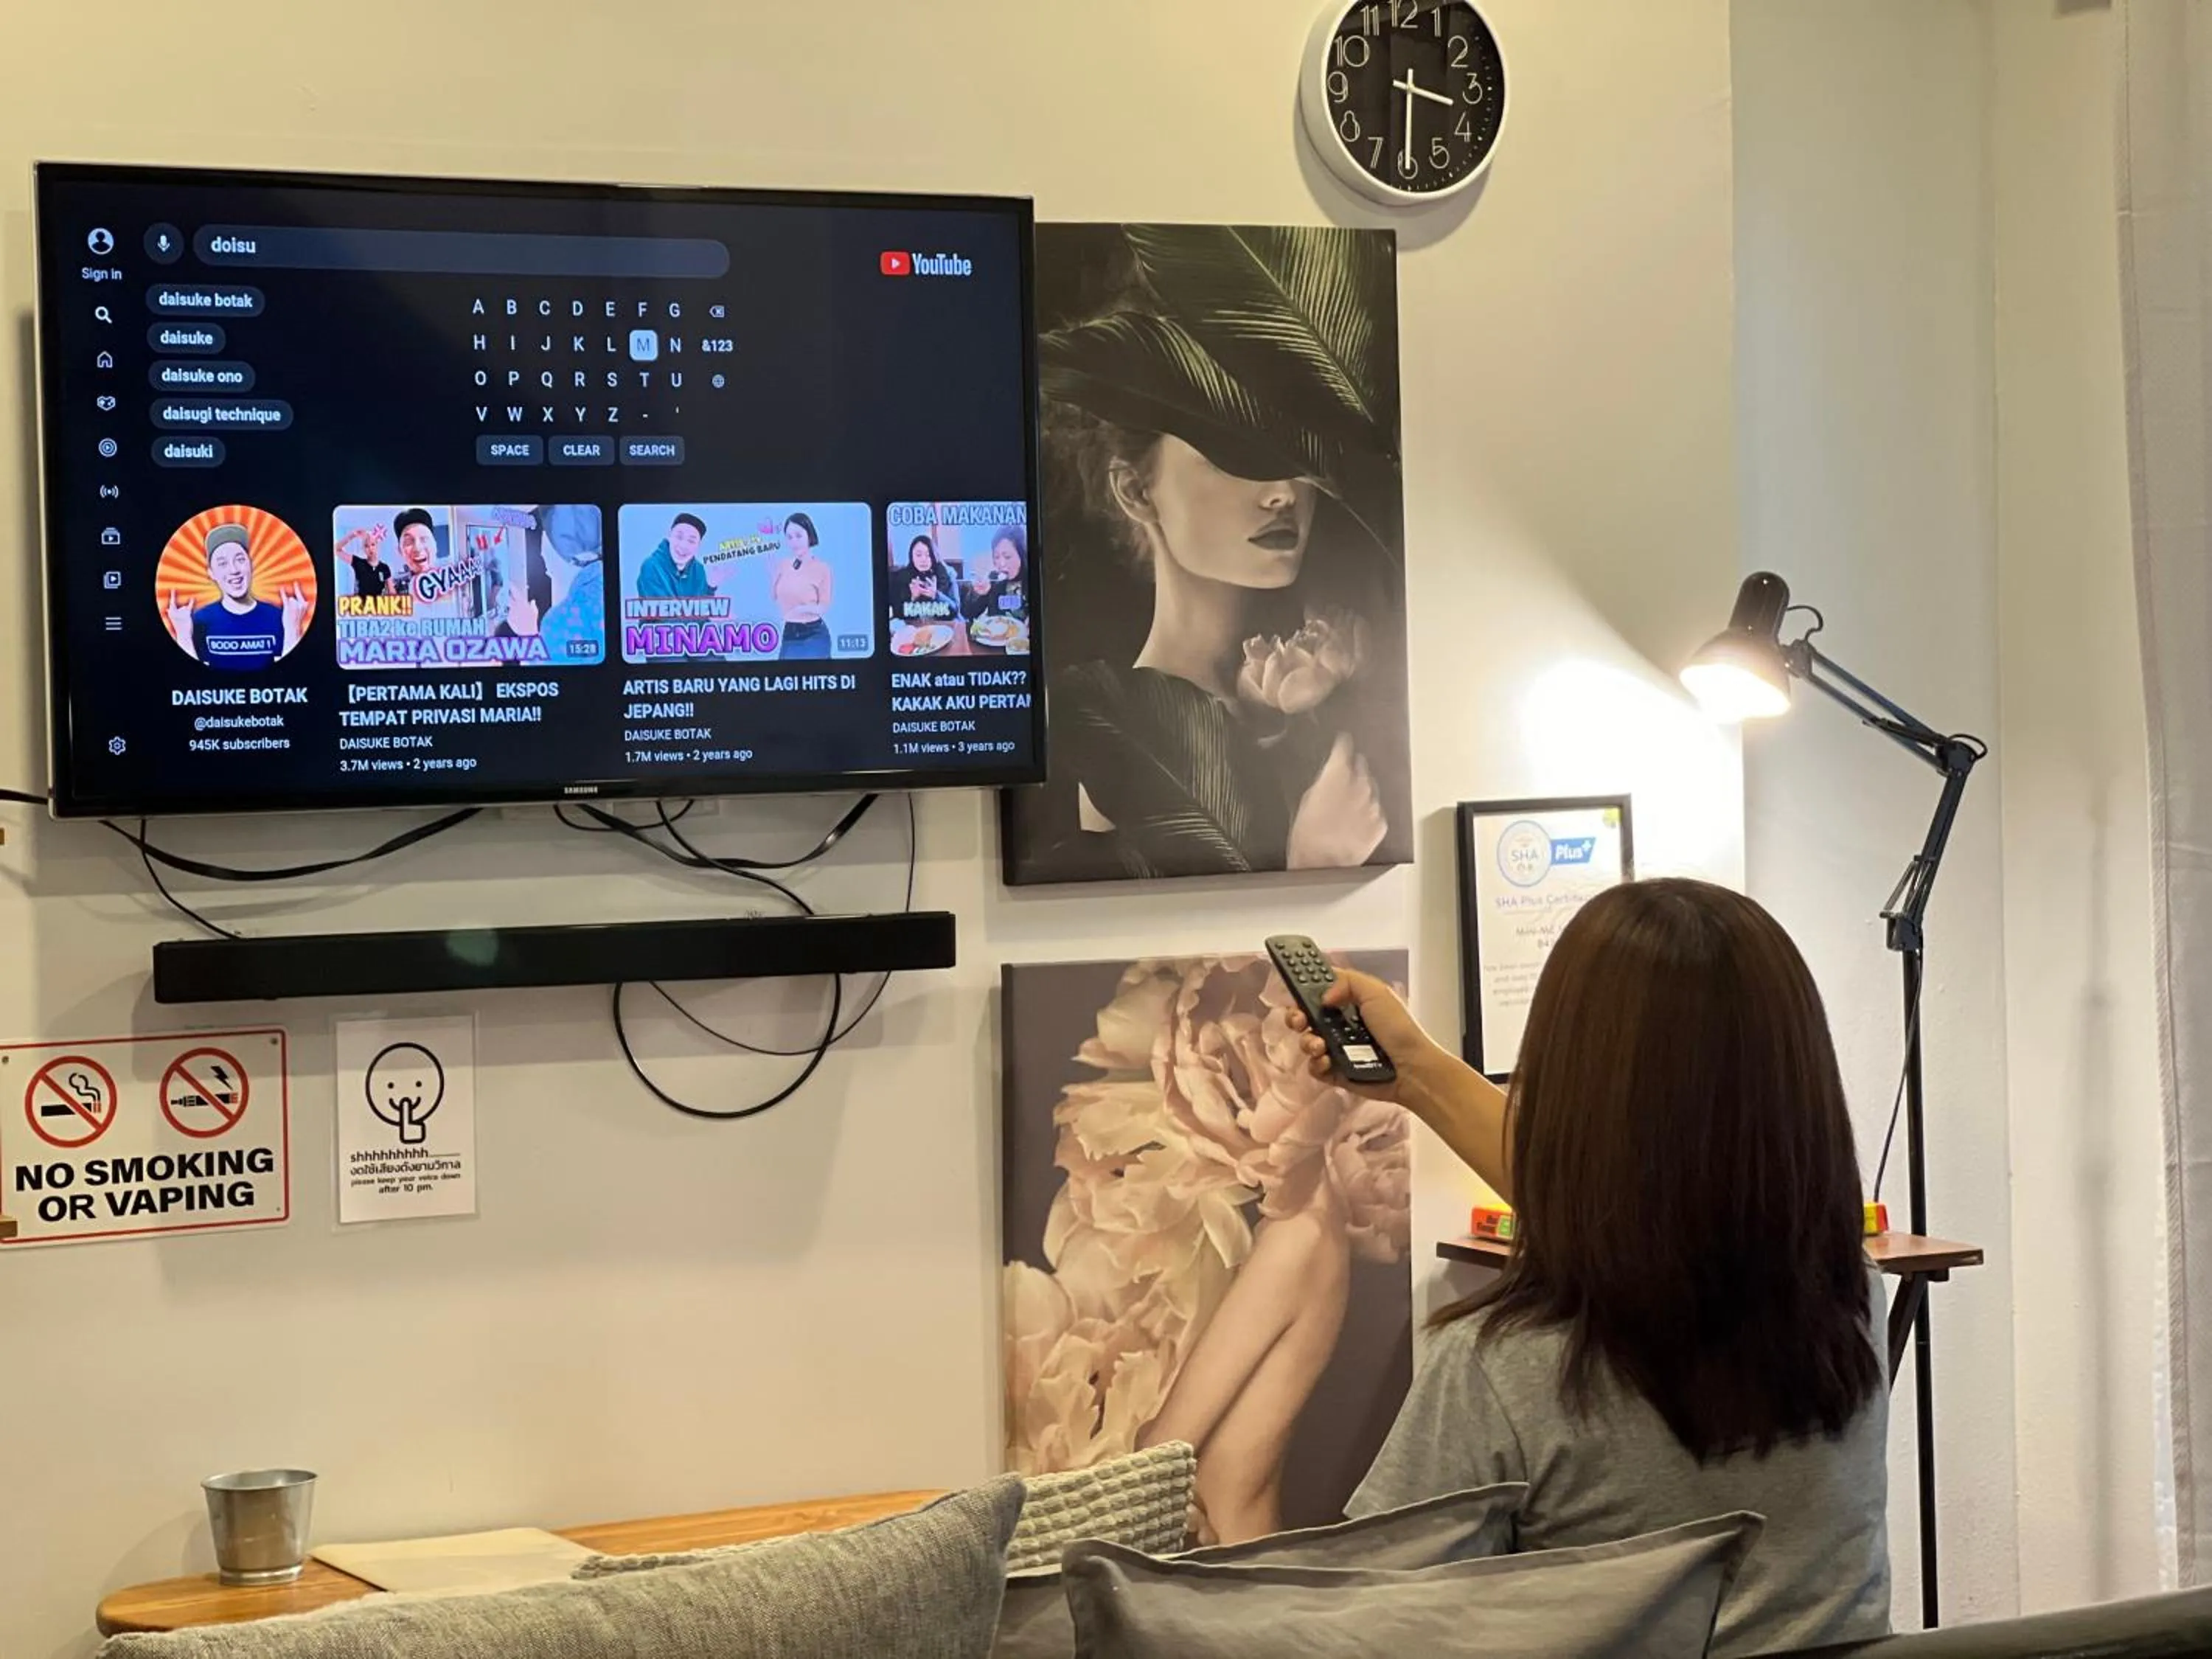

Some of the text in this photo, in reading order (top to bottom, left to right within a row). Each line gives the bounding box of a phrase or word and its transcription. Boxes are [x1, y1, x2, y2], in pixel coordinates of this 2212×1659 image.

[1360, 5, 1380, 36] 11
[1389, 0, 1419, 28] 12
[1430, 7, 1441, 37] 1
[1333, 35, 1370, 67] 10
[1447, 35, 1468, 68] 2
[1327, 72, 1349, 102] 9
[1463, 73, 1483, 104] 3
[1340, 111, 1360, 142] 8
[1454, 112, 1472, 142] 4
[1368, 137, 1384, 169] 7
[1429, 138, 1450, 169] 5
[912, 253, 972, 275] YouTube
[82, 267, 122, 282] Sign in
[159, 291, 253, 307] daisuke botak
[472, 299, 681, 318] A B C D E F G
[160, 330, 213, 345] daisuke
[473, 335, 734, 352] H I J K L M N &123
[161, 367, 243, 383] daisuke ono
[474, 371, 682, 388] O P Q R S T U
[163, 406, 282, 425] daisugi technique
[476, 407, 487, 422] V
[507, 407, 523, 422] W
[543, 407, 554, 422] X
[575, 407, 586, 422] Y
[608, 408, 619, 422] Z
[164, 444, 214, 459] daisuki
[490, 444, 530, 456] SPACE
[563, 445, 601, 456] CLEAR
[630, 445, 675, 456] SEARCH
[889, 505, 938, 525] COBA
[338, 595, 413, 616] PRANK!!
[627, 599, 728, 619] INTERVIEW
[903, 601, 950, 616] KAKAK
[420, 618, 486, 637] RUMAH
[626, 623, 779, 656] MINAMO
[338, 639, 548, 664] MARIA OZAWA
[623, 675, 856, 695] ARTIS BARU YANG LAGI HITS DI
[891, 671, 1026, 688] ENAK atau TIDAK??
[171, 688, 308, 706] DAISUKE BOTAK
[496, 683, 560, 698] EKSPOS
[623, 703, 695, 719] JEPANG!!
[891, 696, 943, 712] KAKAK
[945, 695, 975, 710] AKU
[194, 714, 285, 731] @daisukebotak
[339, 706, 541, 727] TEMPAT PRIVASI MARIA!!
[625, 728, 712, 741] DAISUKE BOTAK
[892, 720, 976, 733] DAISUKE BOTAK
[189, 737, 291, 751] 945K subscribers
[340, 736, 433, 750] DAISUKE BOTAK
[894, 741, 1015, 754] 1.1M views 3 years ago
[625, 749, 753, 764] 1.7M views 2 years ago
[340, 758, 477, 773] 3.7M views 2 years ago
[15, 1148, 274, 1191] NO SMOKING
[403, 1183, 413, 1192] 10
[38, 1181, 254, 1222] OR VAPING
